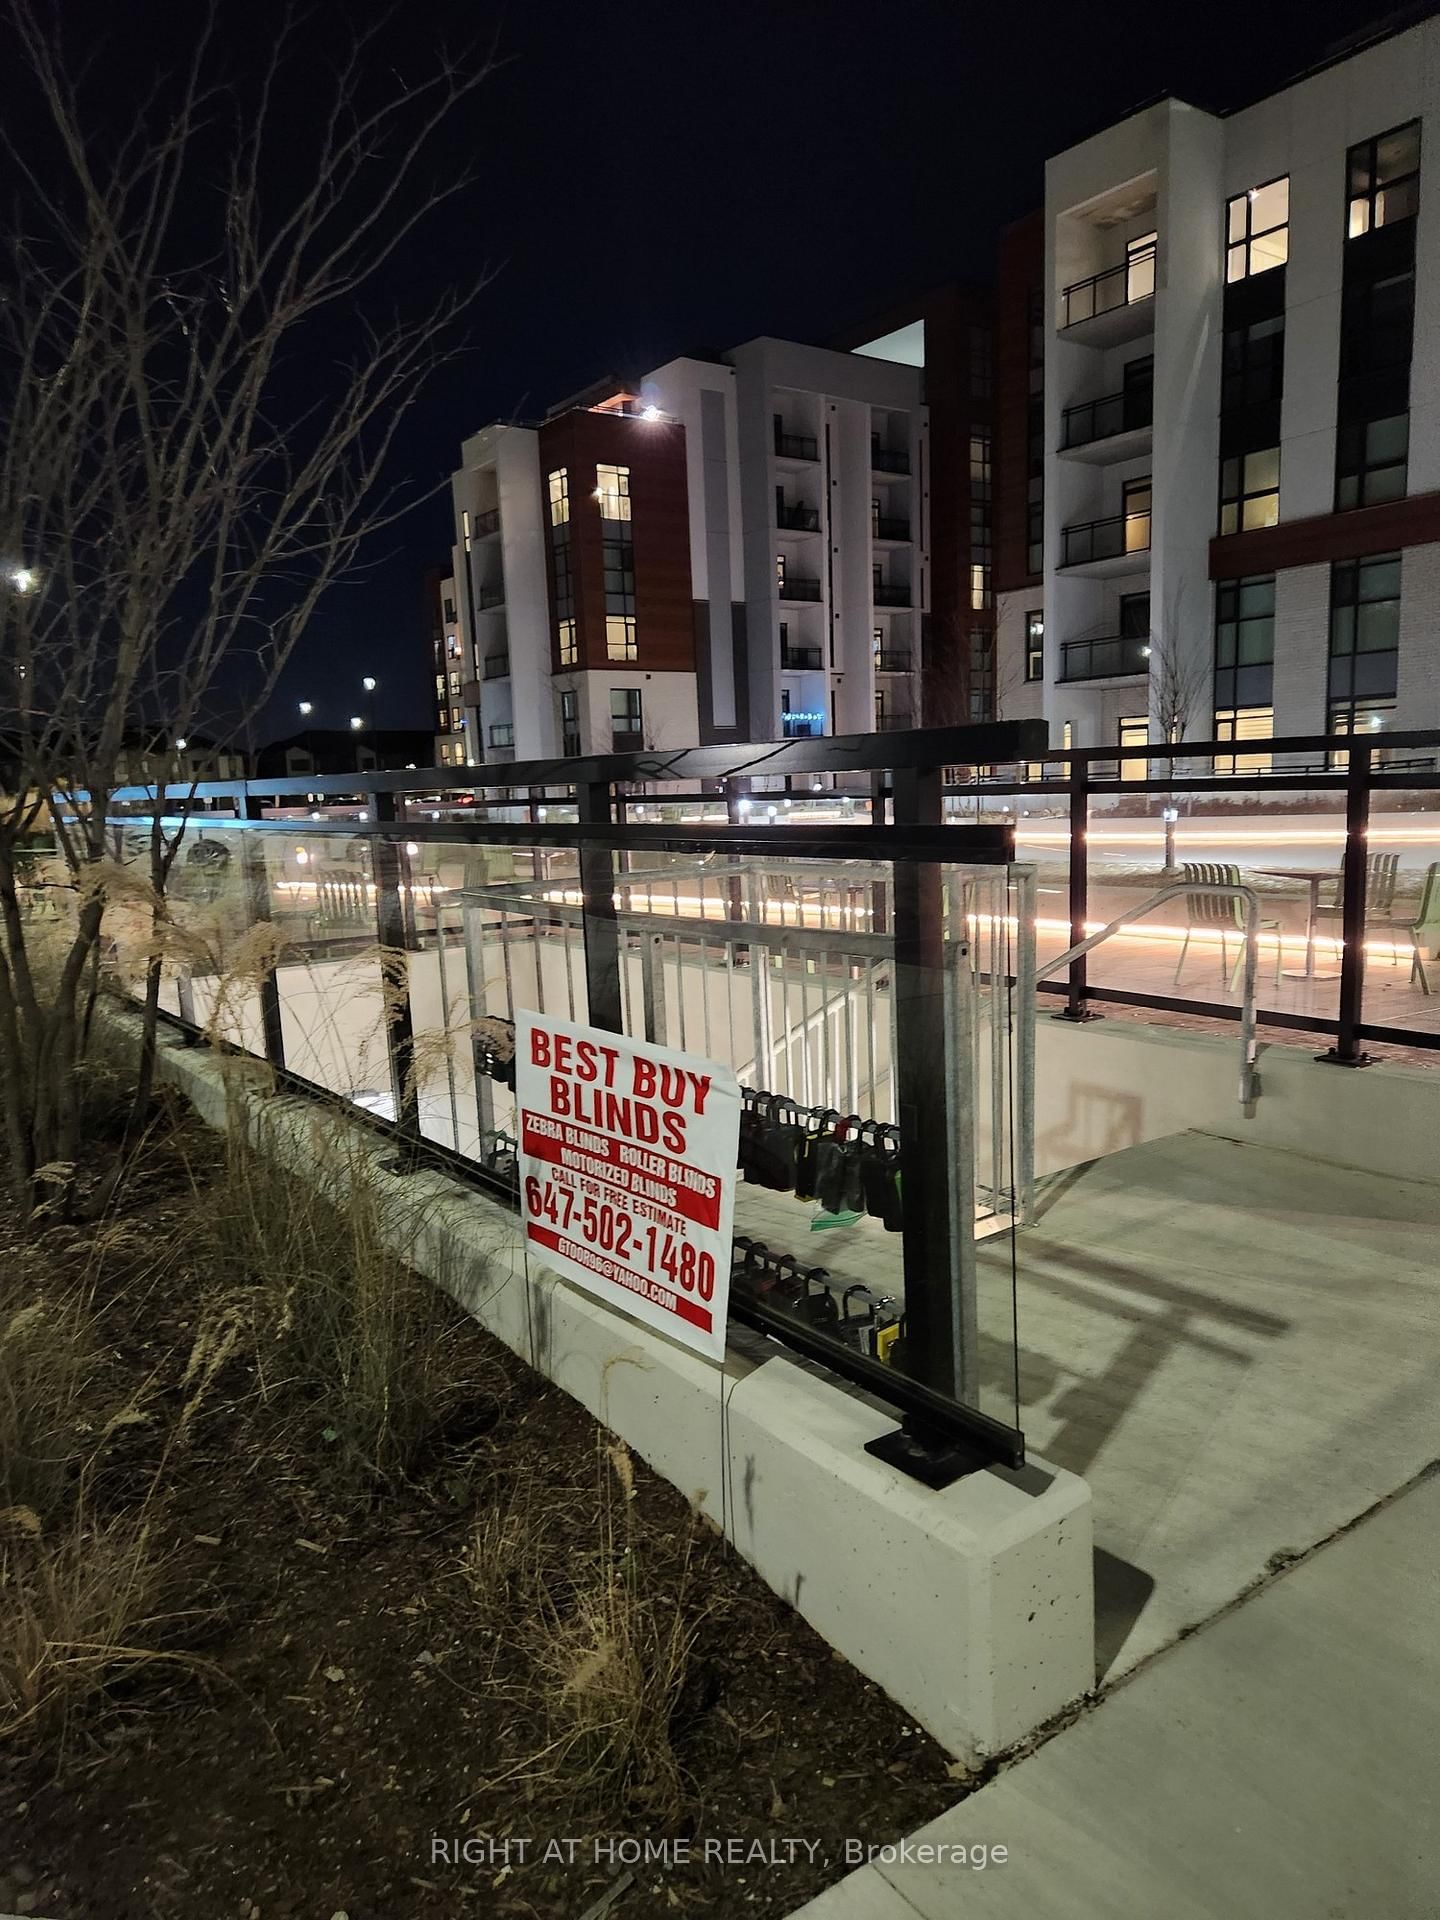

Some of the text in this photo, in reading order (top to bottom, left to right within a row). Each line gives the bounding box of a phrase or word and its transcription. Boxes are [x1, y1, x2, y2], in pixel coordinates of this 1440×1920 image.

[531, 1027, 712, 1115] BEST BUY
[551, 1075, 686, 1154] BLINDS
[526, 1114, 716, 1198] ZEBRA BLINDS ROLLER BLINDS
[561, 1148, 677, 1207] MOTORIZED BLINDS
[526, 1175, 714, 1302] 647-502-1480
[552, 1167, 686, 1236] CALL FOR FREE ESTIMATE
